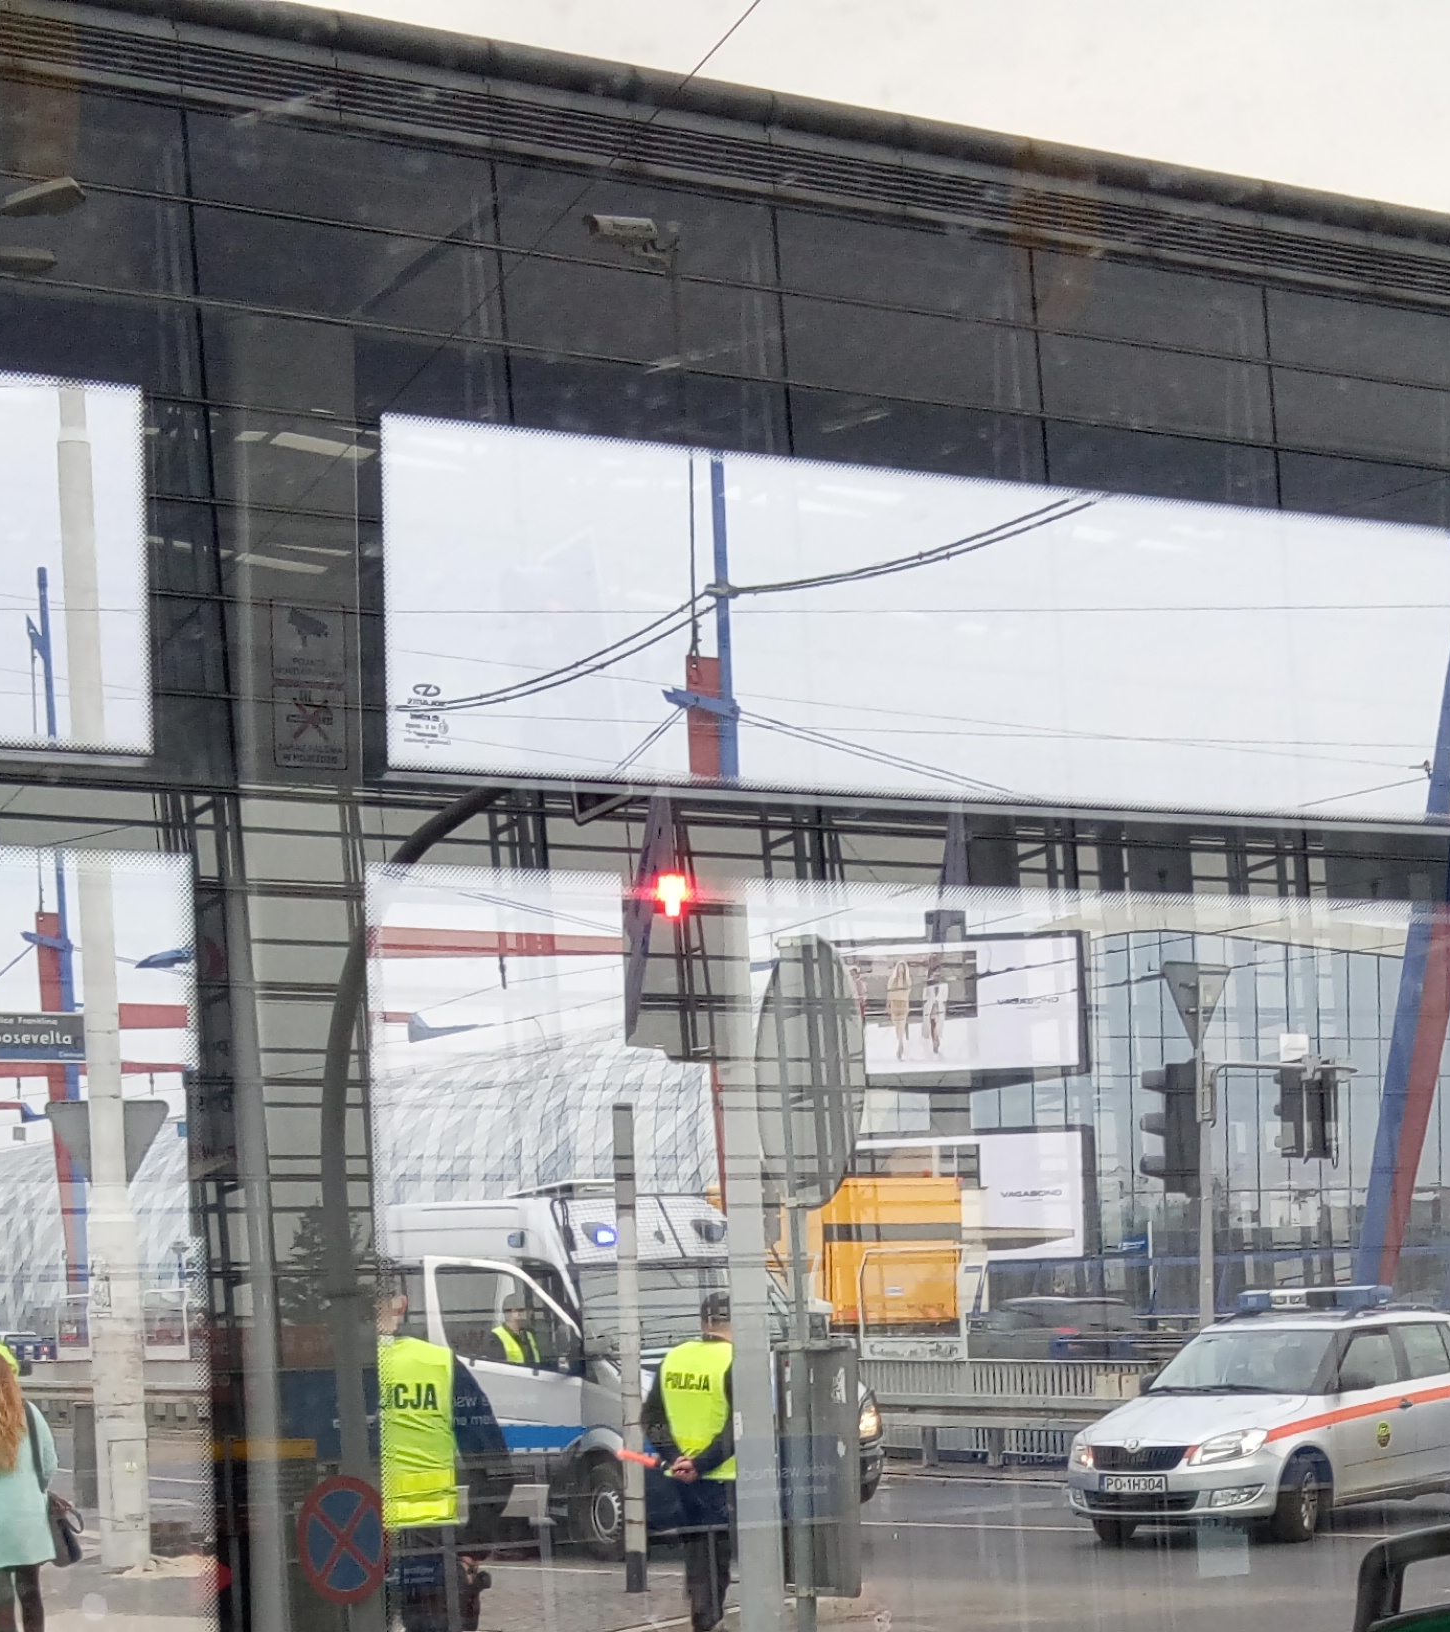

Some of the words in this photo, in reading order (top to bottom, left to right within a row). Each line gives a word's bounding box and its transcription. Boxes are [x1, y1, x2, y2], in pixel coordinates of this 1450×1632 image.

[996, 996, 1060, 1007] VAGABOND
[999, 1188, 1063, 1198] VAGABOND
[664, 1371, 711, 1392] POLICJA
[1105, 1476, 1124, 1491] PO
[1126, 1477, 1164, 1492] 1H304
